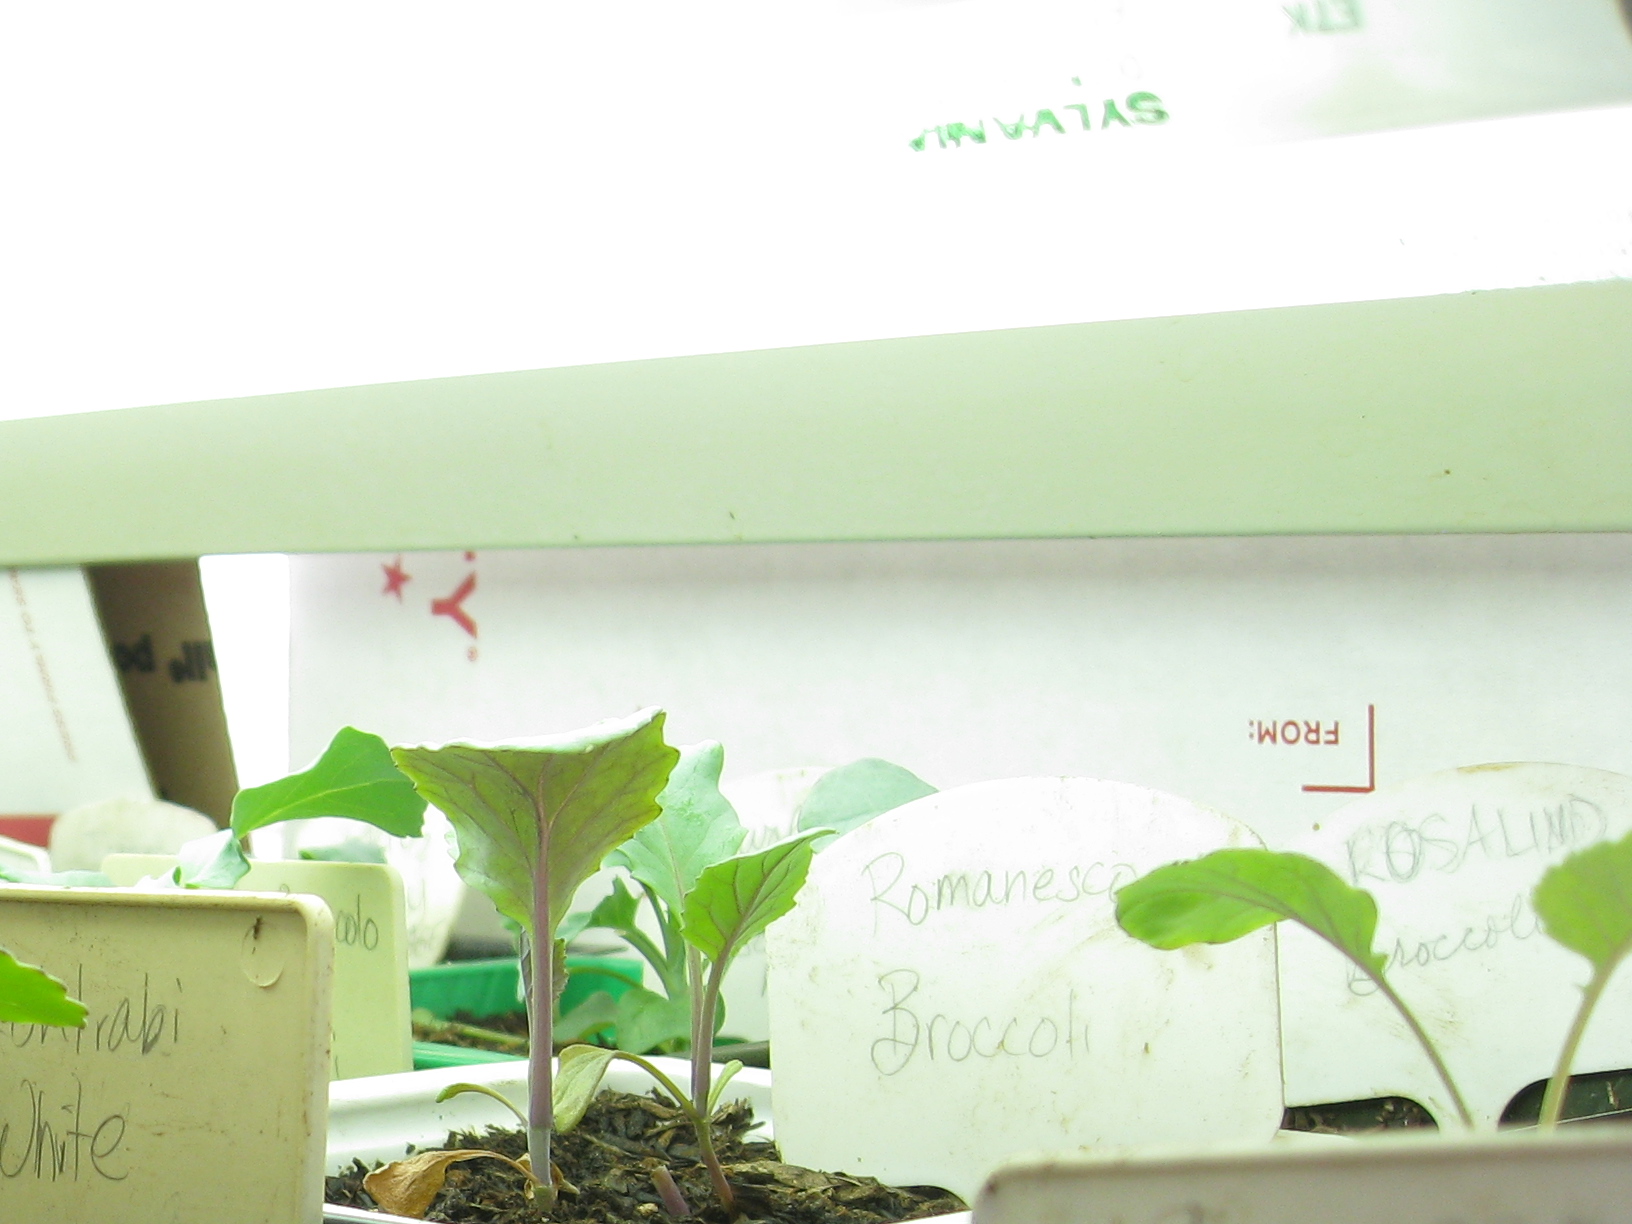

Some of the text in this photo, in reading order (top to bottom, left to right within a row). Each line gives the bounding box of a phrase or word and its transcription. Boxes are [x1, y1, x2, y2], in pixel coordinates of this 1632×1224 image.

[1248, 718, 1340, 746] FROM:
[862, 851, 1138, 935] Romanesco
[871, 968, 1091, 1076] Broccoli
